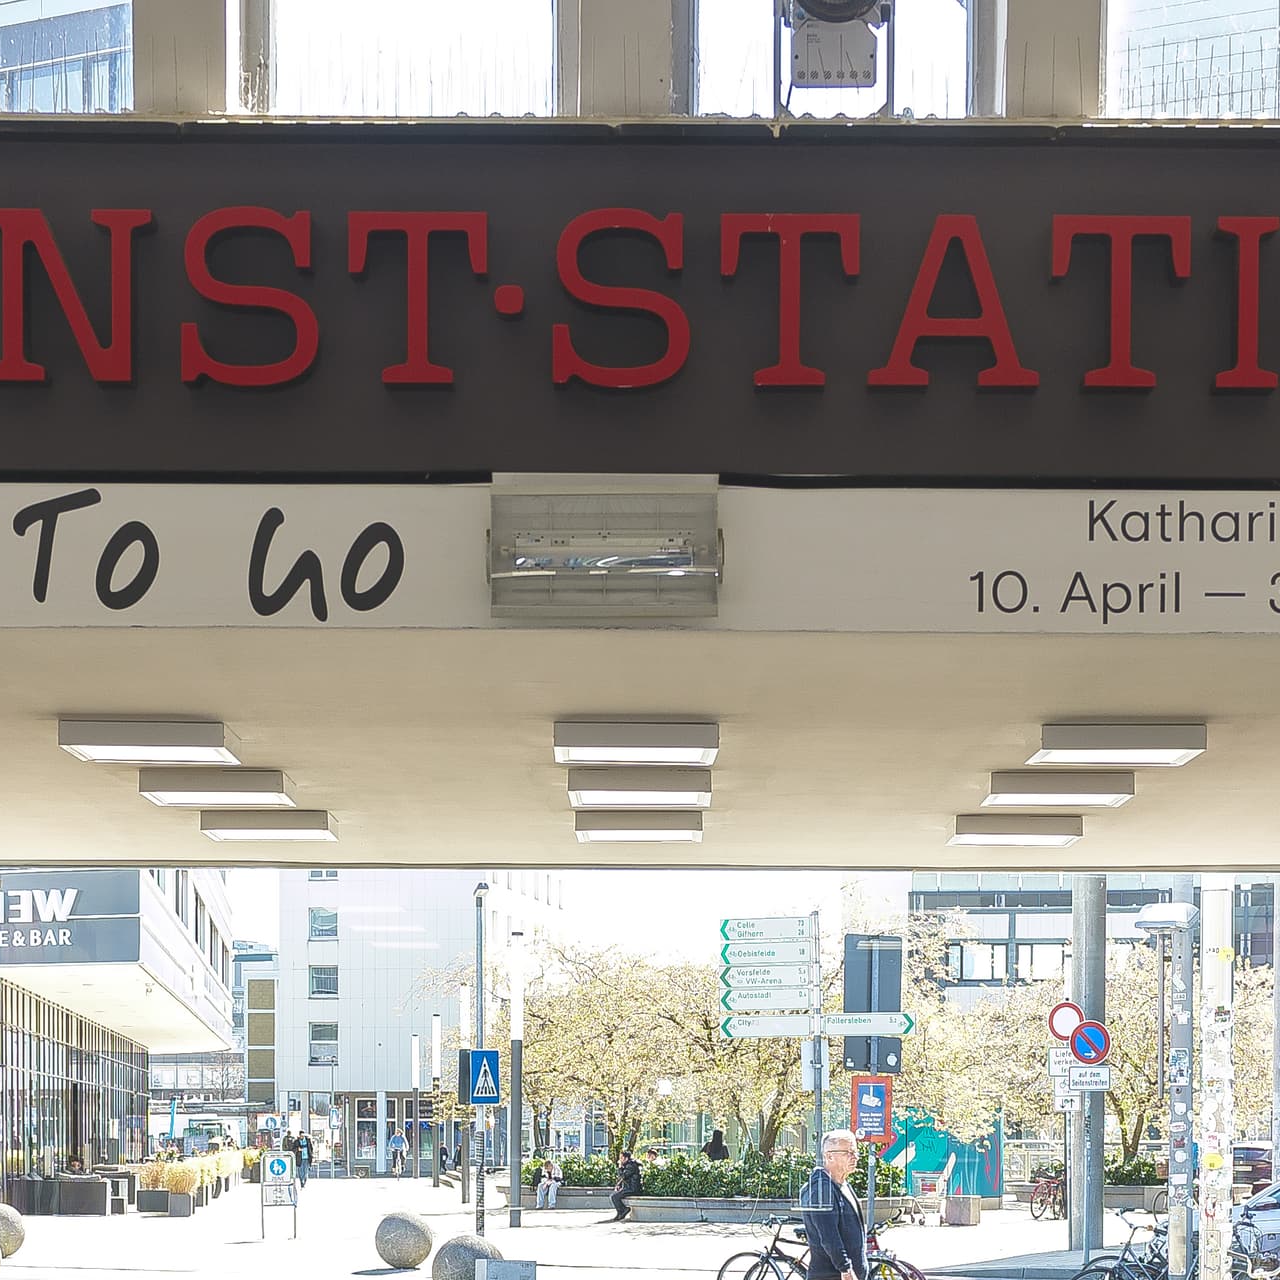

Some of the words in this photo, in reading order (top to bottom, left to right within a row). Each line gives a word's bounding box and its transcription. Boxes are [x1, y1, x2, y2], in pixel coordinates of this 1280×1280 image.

[12, 488, 161, 611] TO
[247, 507, 406, 622] GO
[968, 570, 1040, 614] 10.
[1059, 570, 1184, 625] April
[736, 921, 756, 929] Celle
[736, 930, 764, 938] Gifhorn
[736, 949, 776, 957] Oebisfelde
[736, 968, 771, 976] Vorsfelde
[745, 977, 782, 985] VW-Arena
[737, 991, 772, 999] Autostadt
[826, 1016, 872, 1024] Fallersleben
[1071, 1079, 1109, 1087] Seitenstreifen
